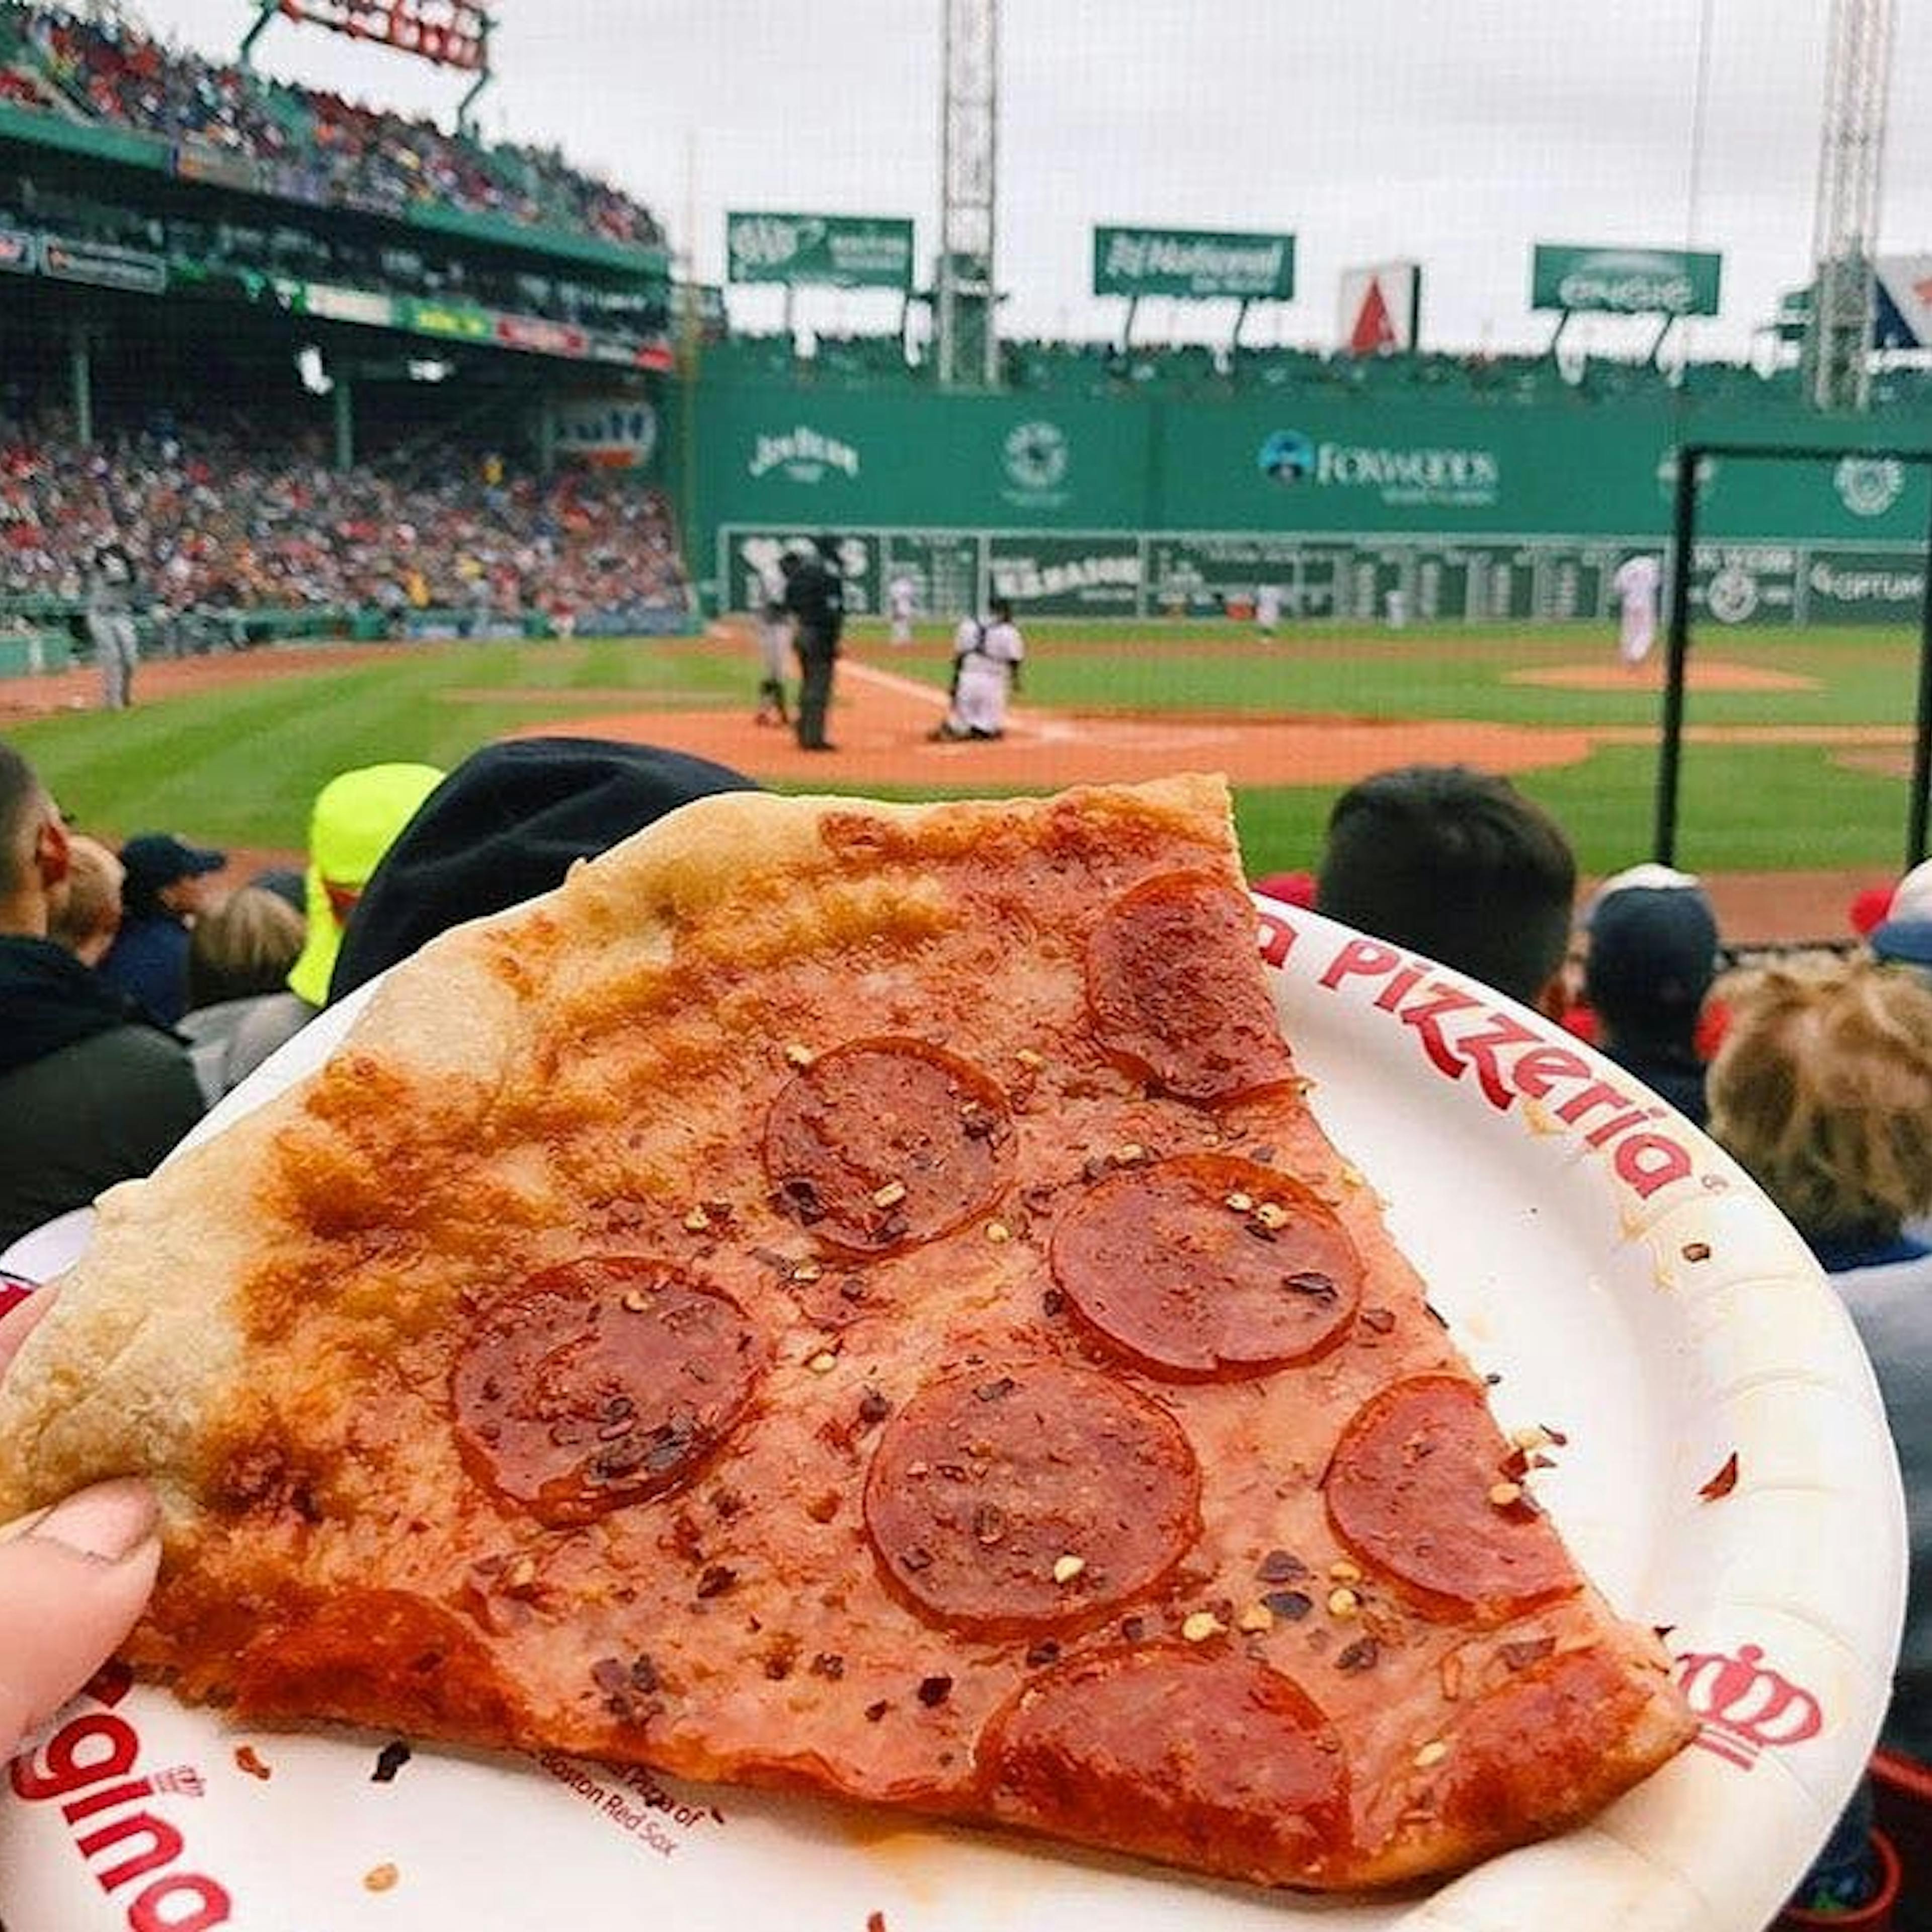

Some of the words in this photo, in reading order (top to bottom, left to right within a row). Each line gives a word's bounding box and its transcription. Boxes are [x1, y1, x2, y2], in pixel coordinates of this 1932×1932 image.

[10, 1662, 231, 1931] gina
[602, 1795, 647, 1830] Red
[638, 1821, 678, 1857] Sox
[674, 1807, 705, 1827] of
